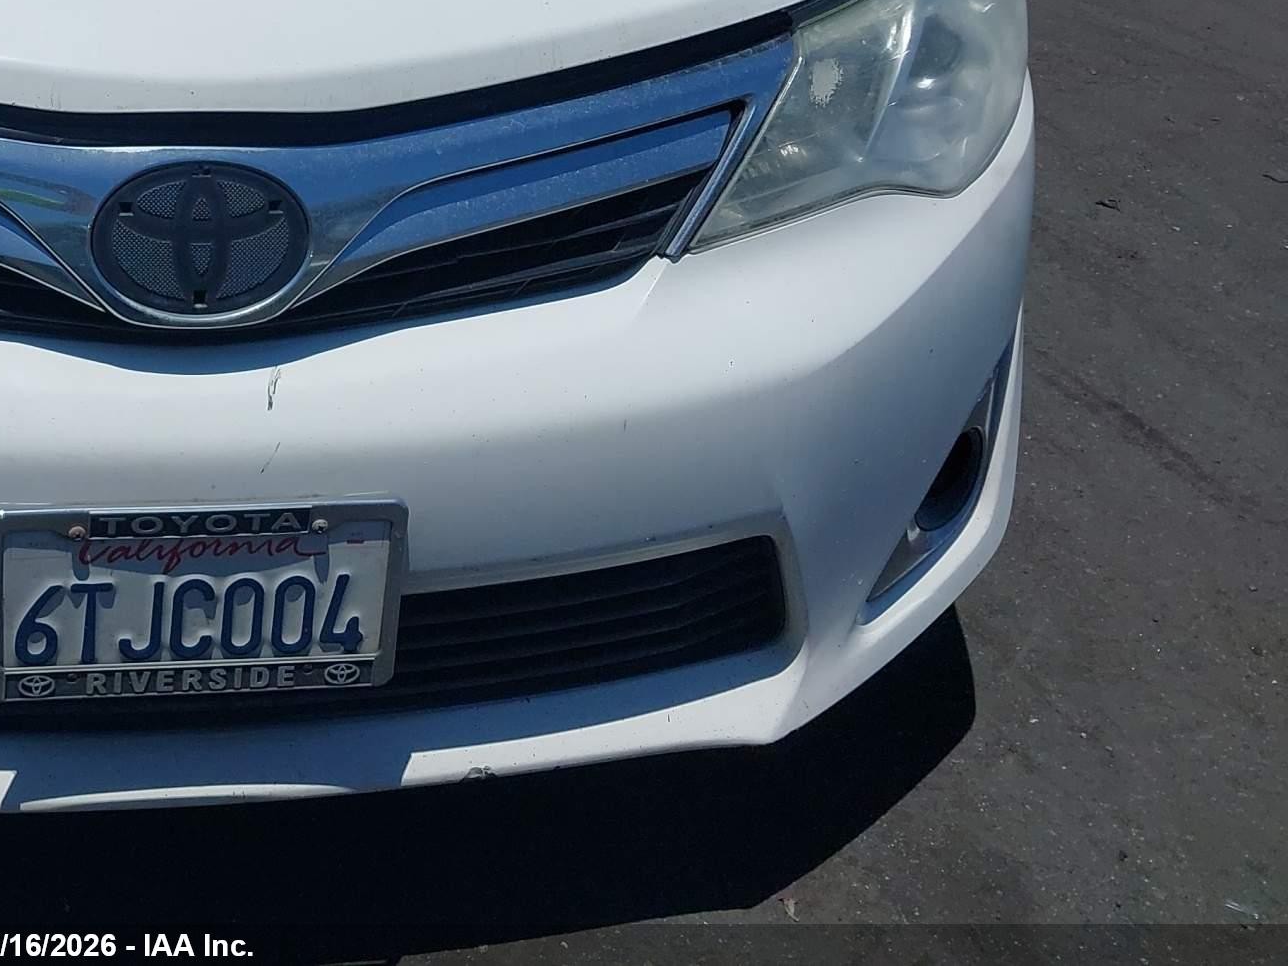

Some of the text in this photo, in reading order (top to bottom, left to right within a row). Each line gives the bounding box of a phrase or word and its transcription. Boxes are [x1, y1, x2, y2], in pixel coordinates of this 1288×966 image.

[98, 512, 302, 535] TOYOTA
[78, 534, 328, 575] California
[15, 573, 364, 666] 6TJC004
[86, 665, 297, 695] RIVERSIDE
